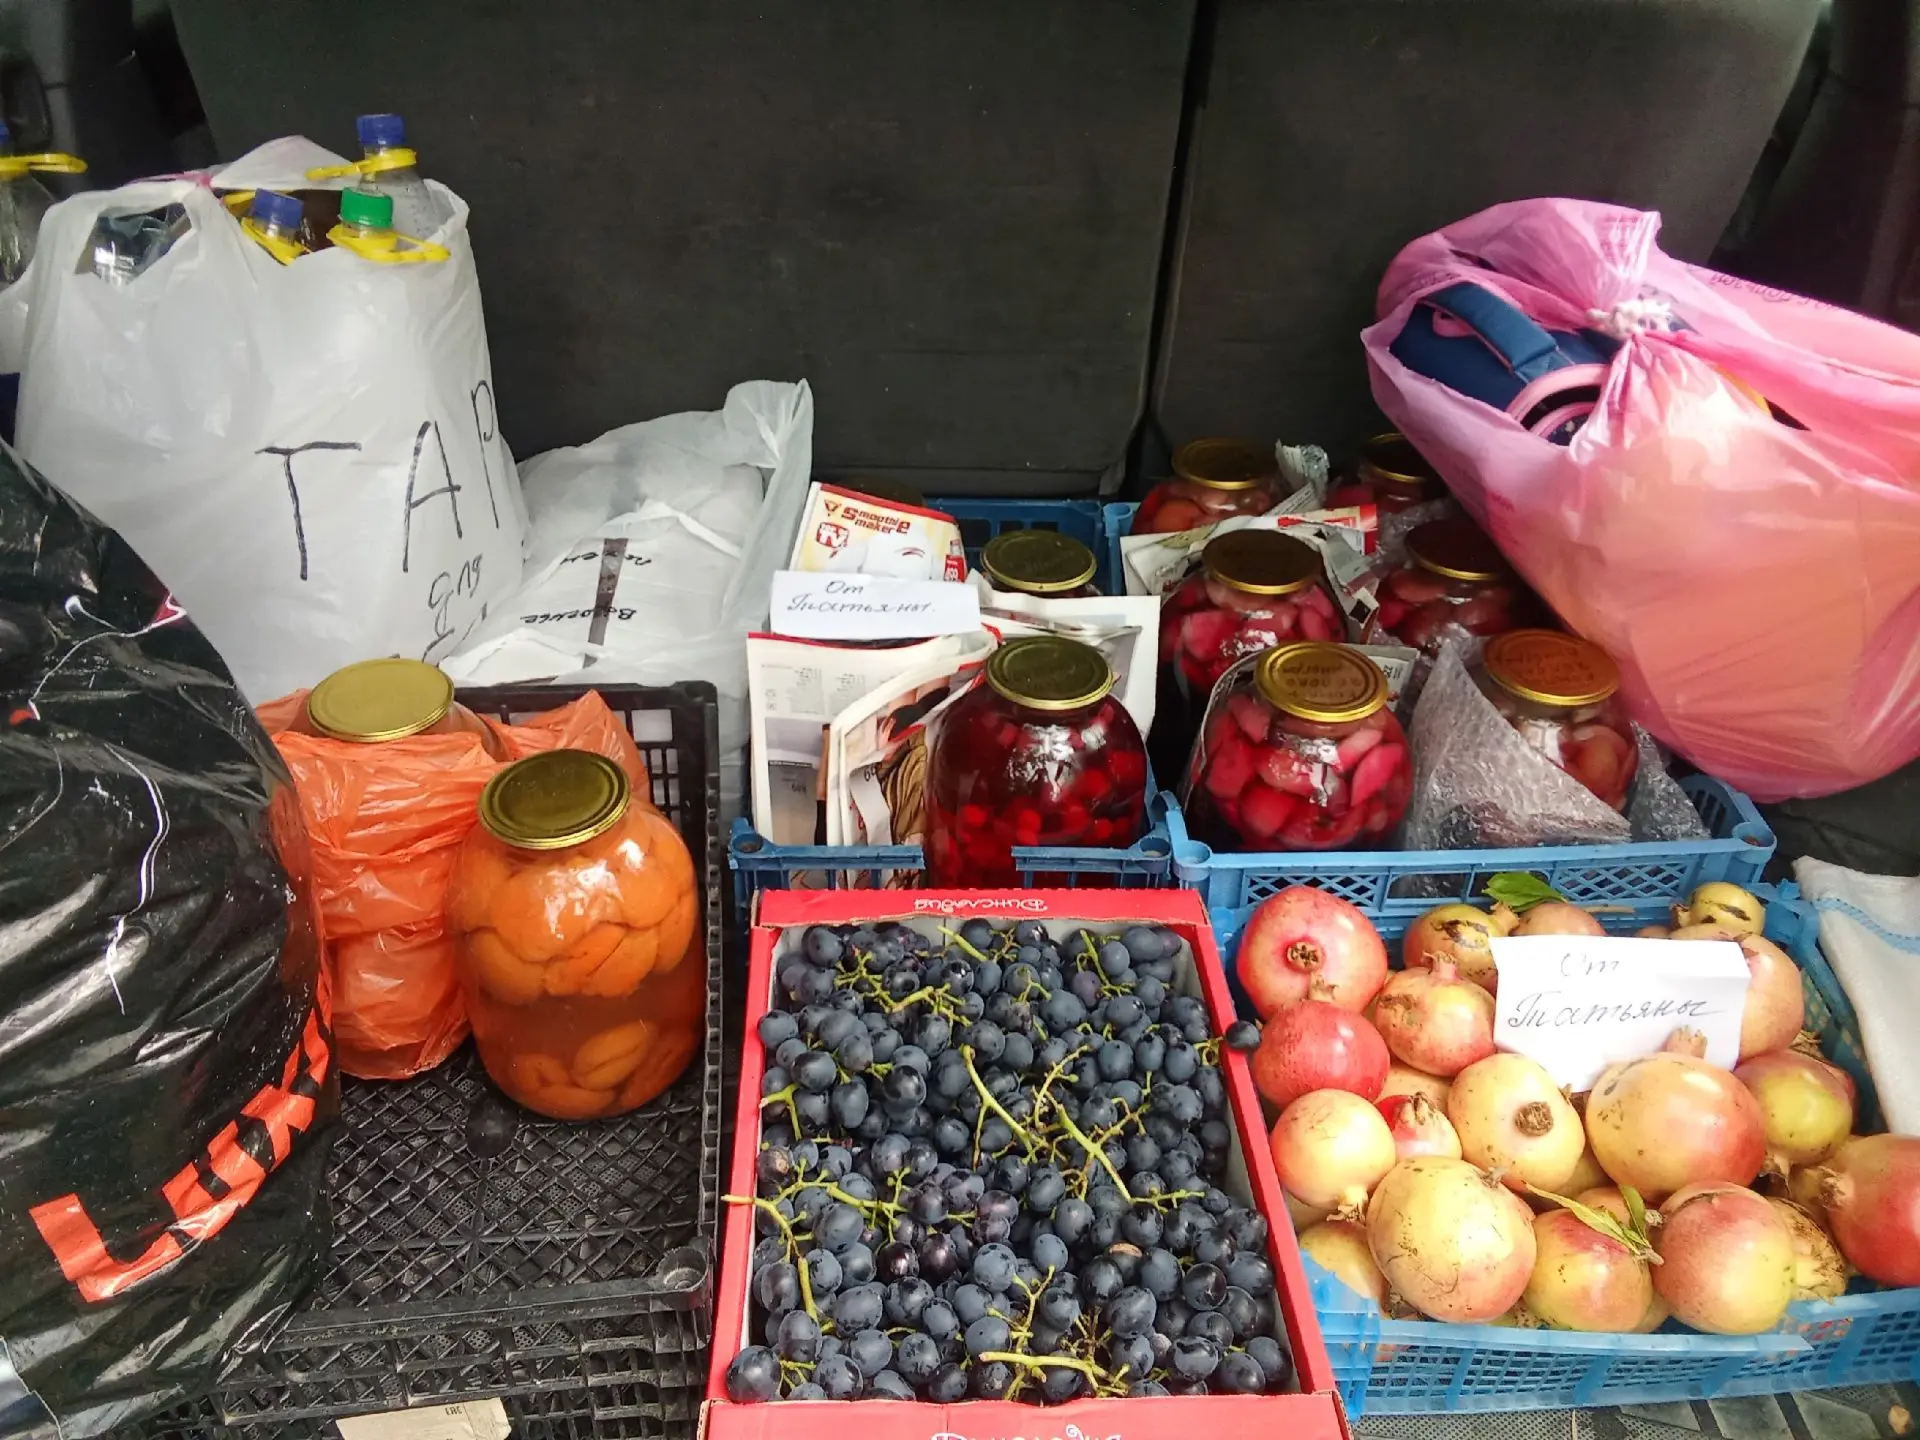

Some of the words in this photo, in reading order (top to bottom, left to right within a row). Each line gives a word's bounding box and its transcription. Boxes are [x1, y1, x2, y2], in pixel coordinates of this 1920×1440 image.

[855, 519, 896, 535] maker
[826, 580, 864, 595] От
[1560, 952, 1619, 977] От
[1508, 990, 1727, 1028] Татьяны
